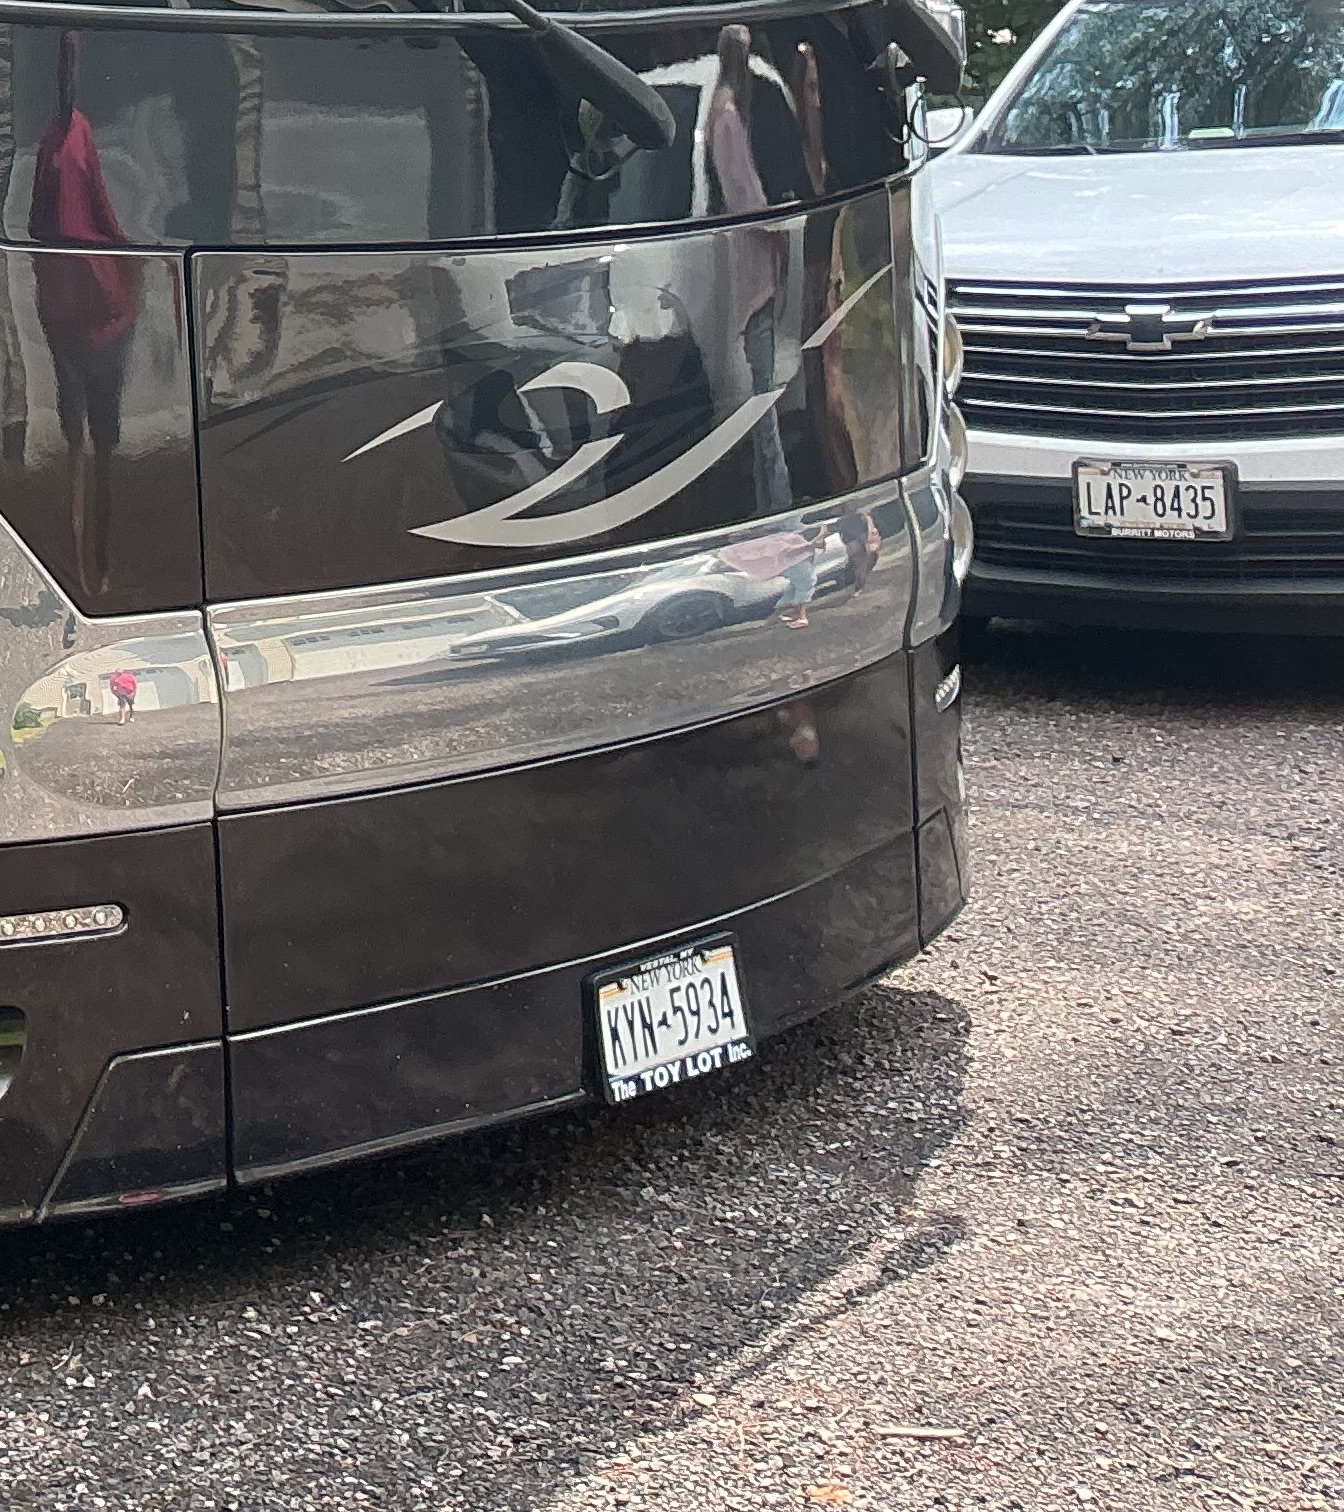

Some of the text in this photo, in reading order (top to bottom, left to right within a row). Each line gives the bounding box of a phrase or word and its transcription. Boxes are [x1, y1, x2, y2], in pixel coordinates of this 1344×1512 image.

[1113, 469, 1188, 482] NEW YORK
[1154, 529, 1195, 539] MOTORS
[629, 956, 703, 995] NEW YORK
[610, 1042, 752, 1102] The TOY LOT Inc.
